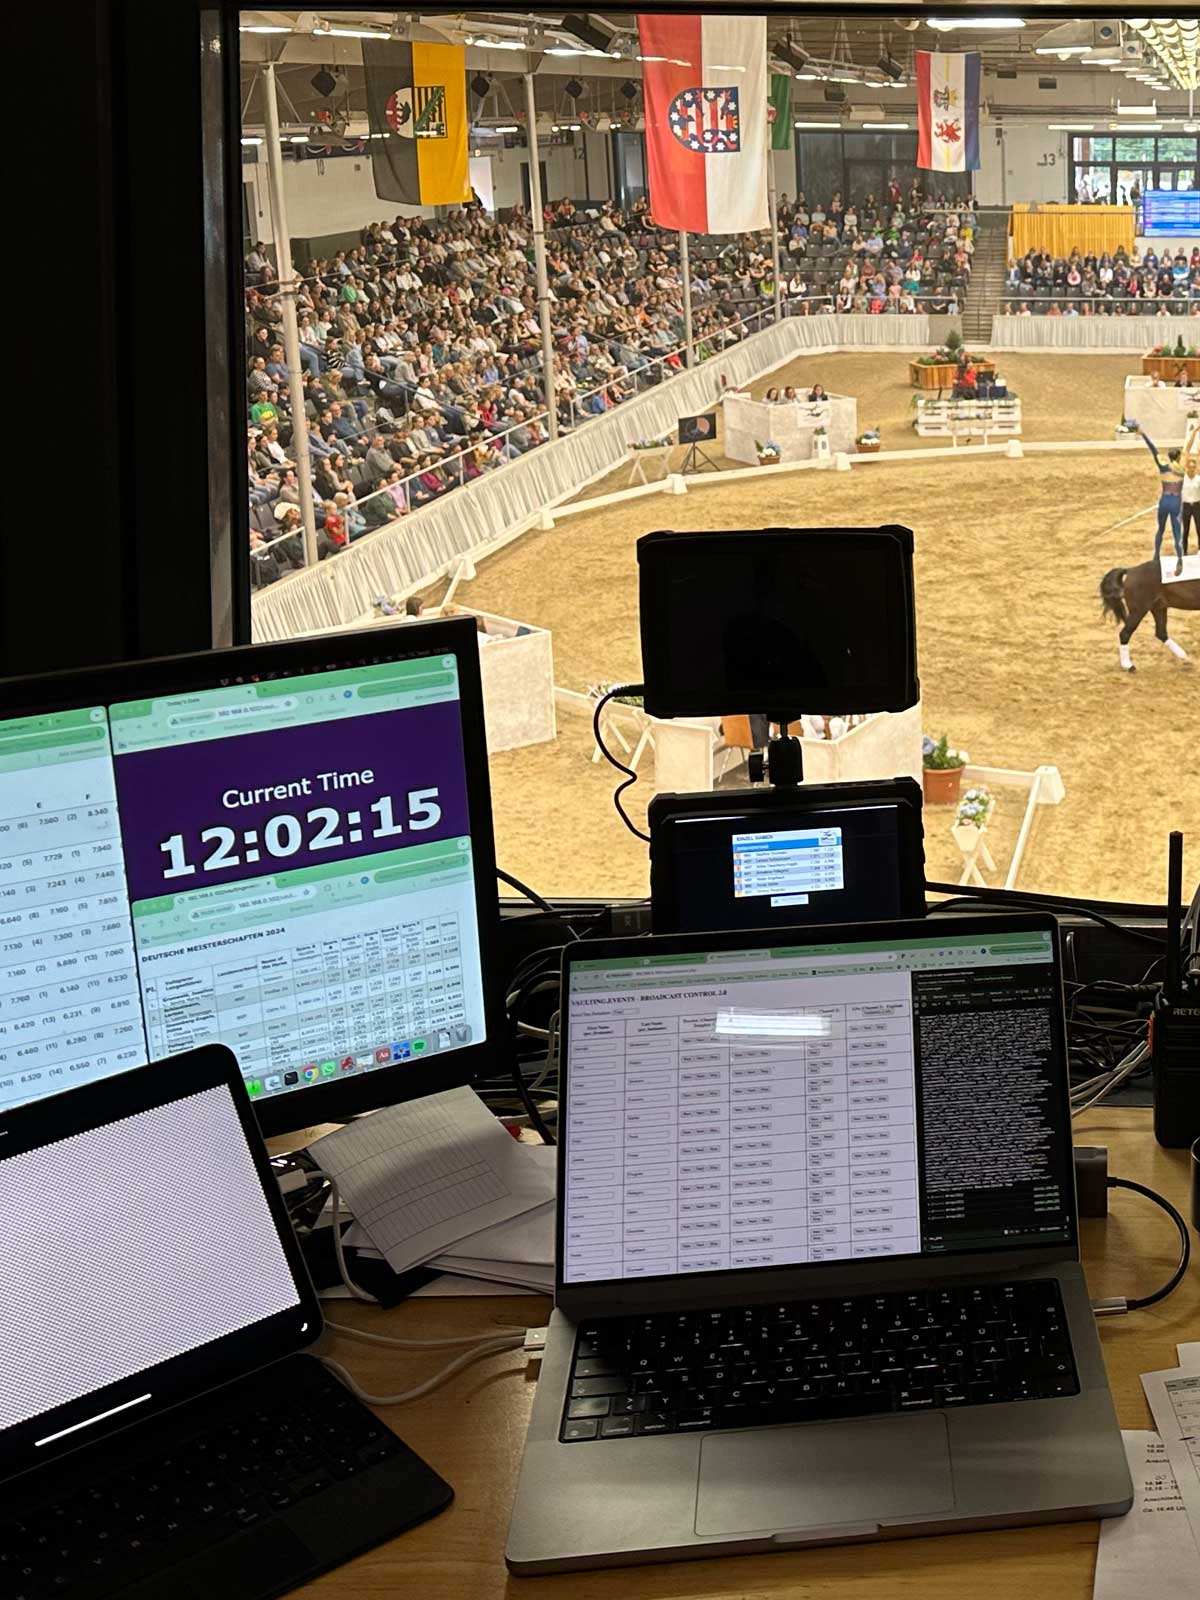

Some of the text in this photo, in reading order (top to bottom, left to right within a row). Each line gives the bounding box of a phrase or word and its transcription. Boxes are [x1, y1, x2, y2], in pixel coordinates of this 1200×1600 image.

[1042, 154, 1056, 166] 13
[222, 769, 375, 809] Current Time
[159, 787, 443, 879] 12:02:15
[141, 926, 286, 964] DEUTSCHE MEISTERSCHAFTEN 2024
[640, 993, 683, 1002] BROADCAST
[683, 991, 716, 1000] CONTROL
